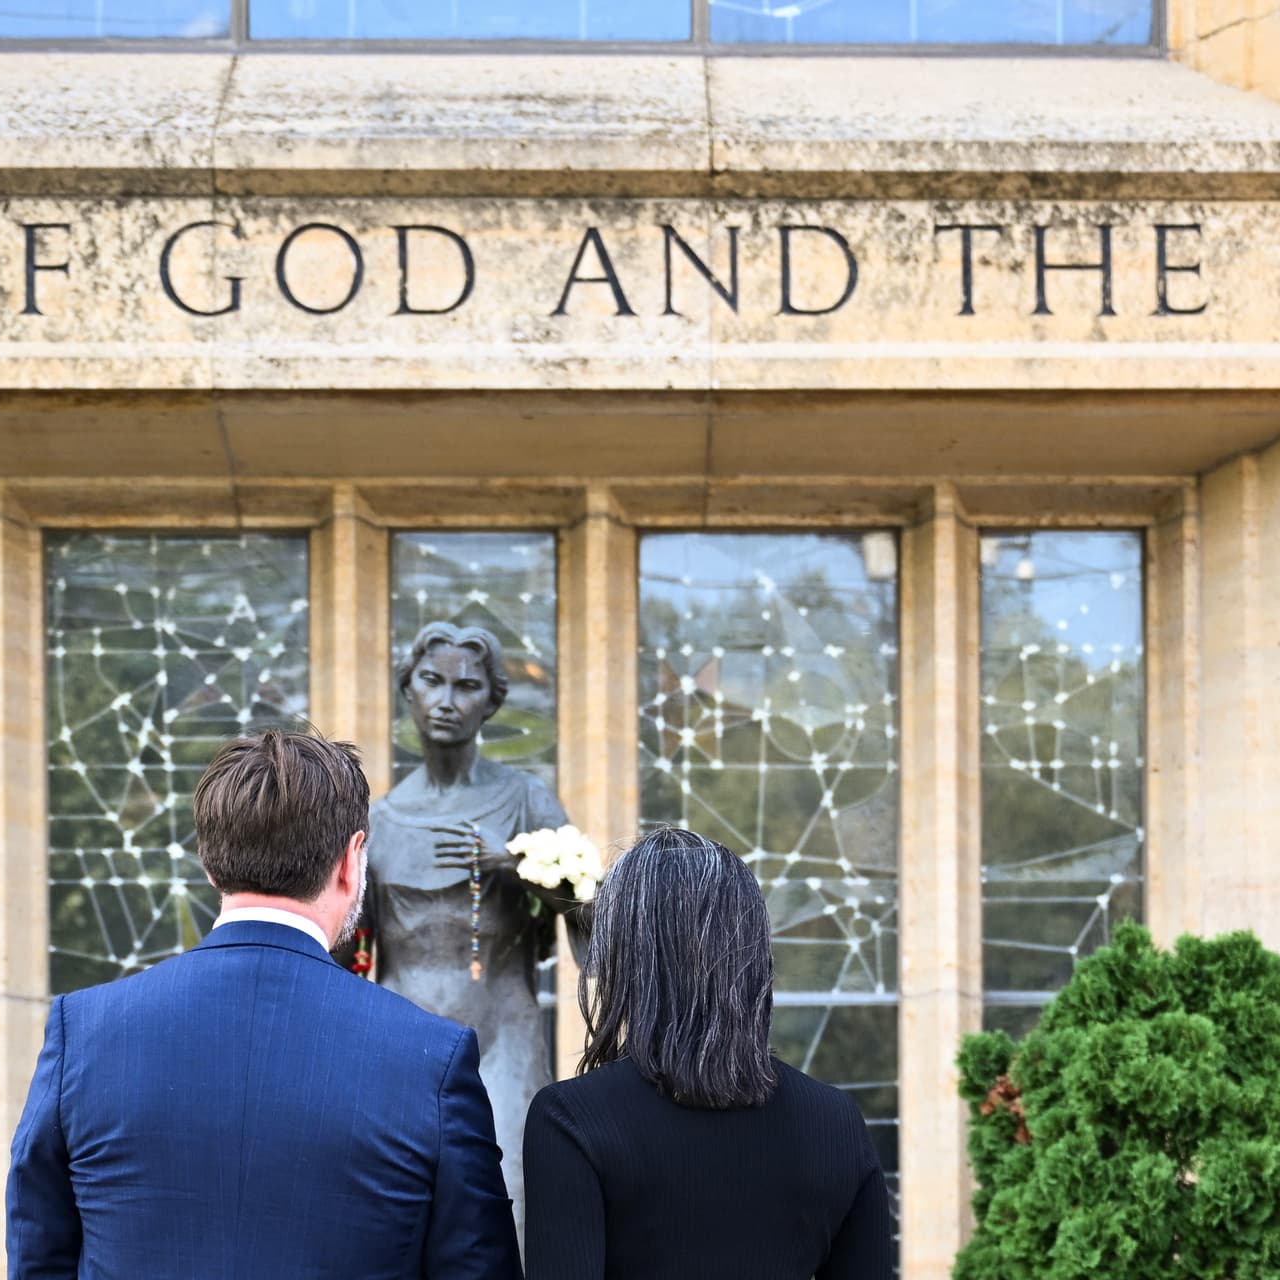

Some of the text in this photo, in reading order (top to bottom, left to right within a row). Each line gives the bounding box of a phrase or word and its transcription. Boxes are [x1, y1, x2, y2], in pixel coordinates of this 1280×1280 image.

[159, 220, 477, 318] GOD
[550, 224, 859, 318] AND
[933, 221, 1208, 318] THE
